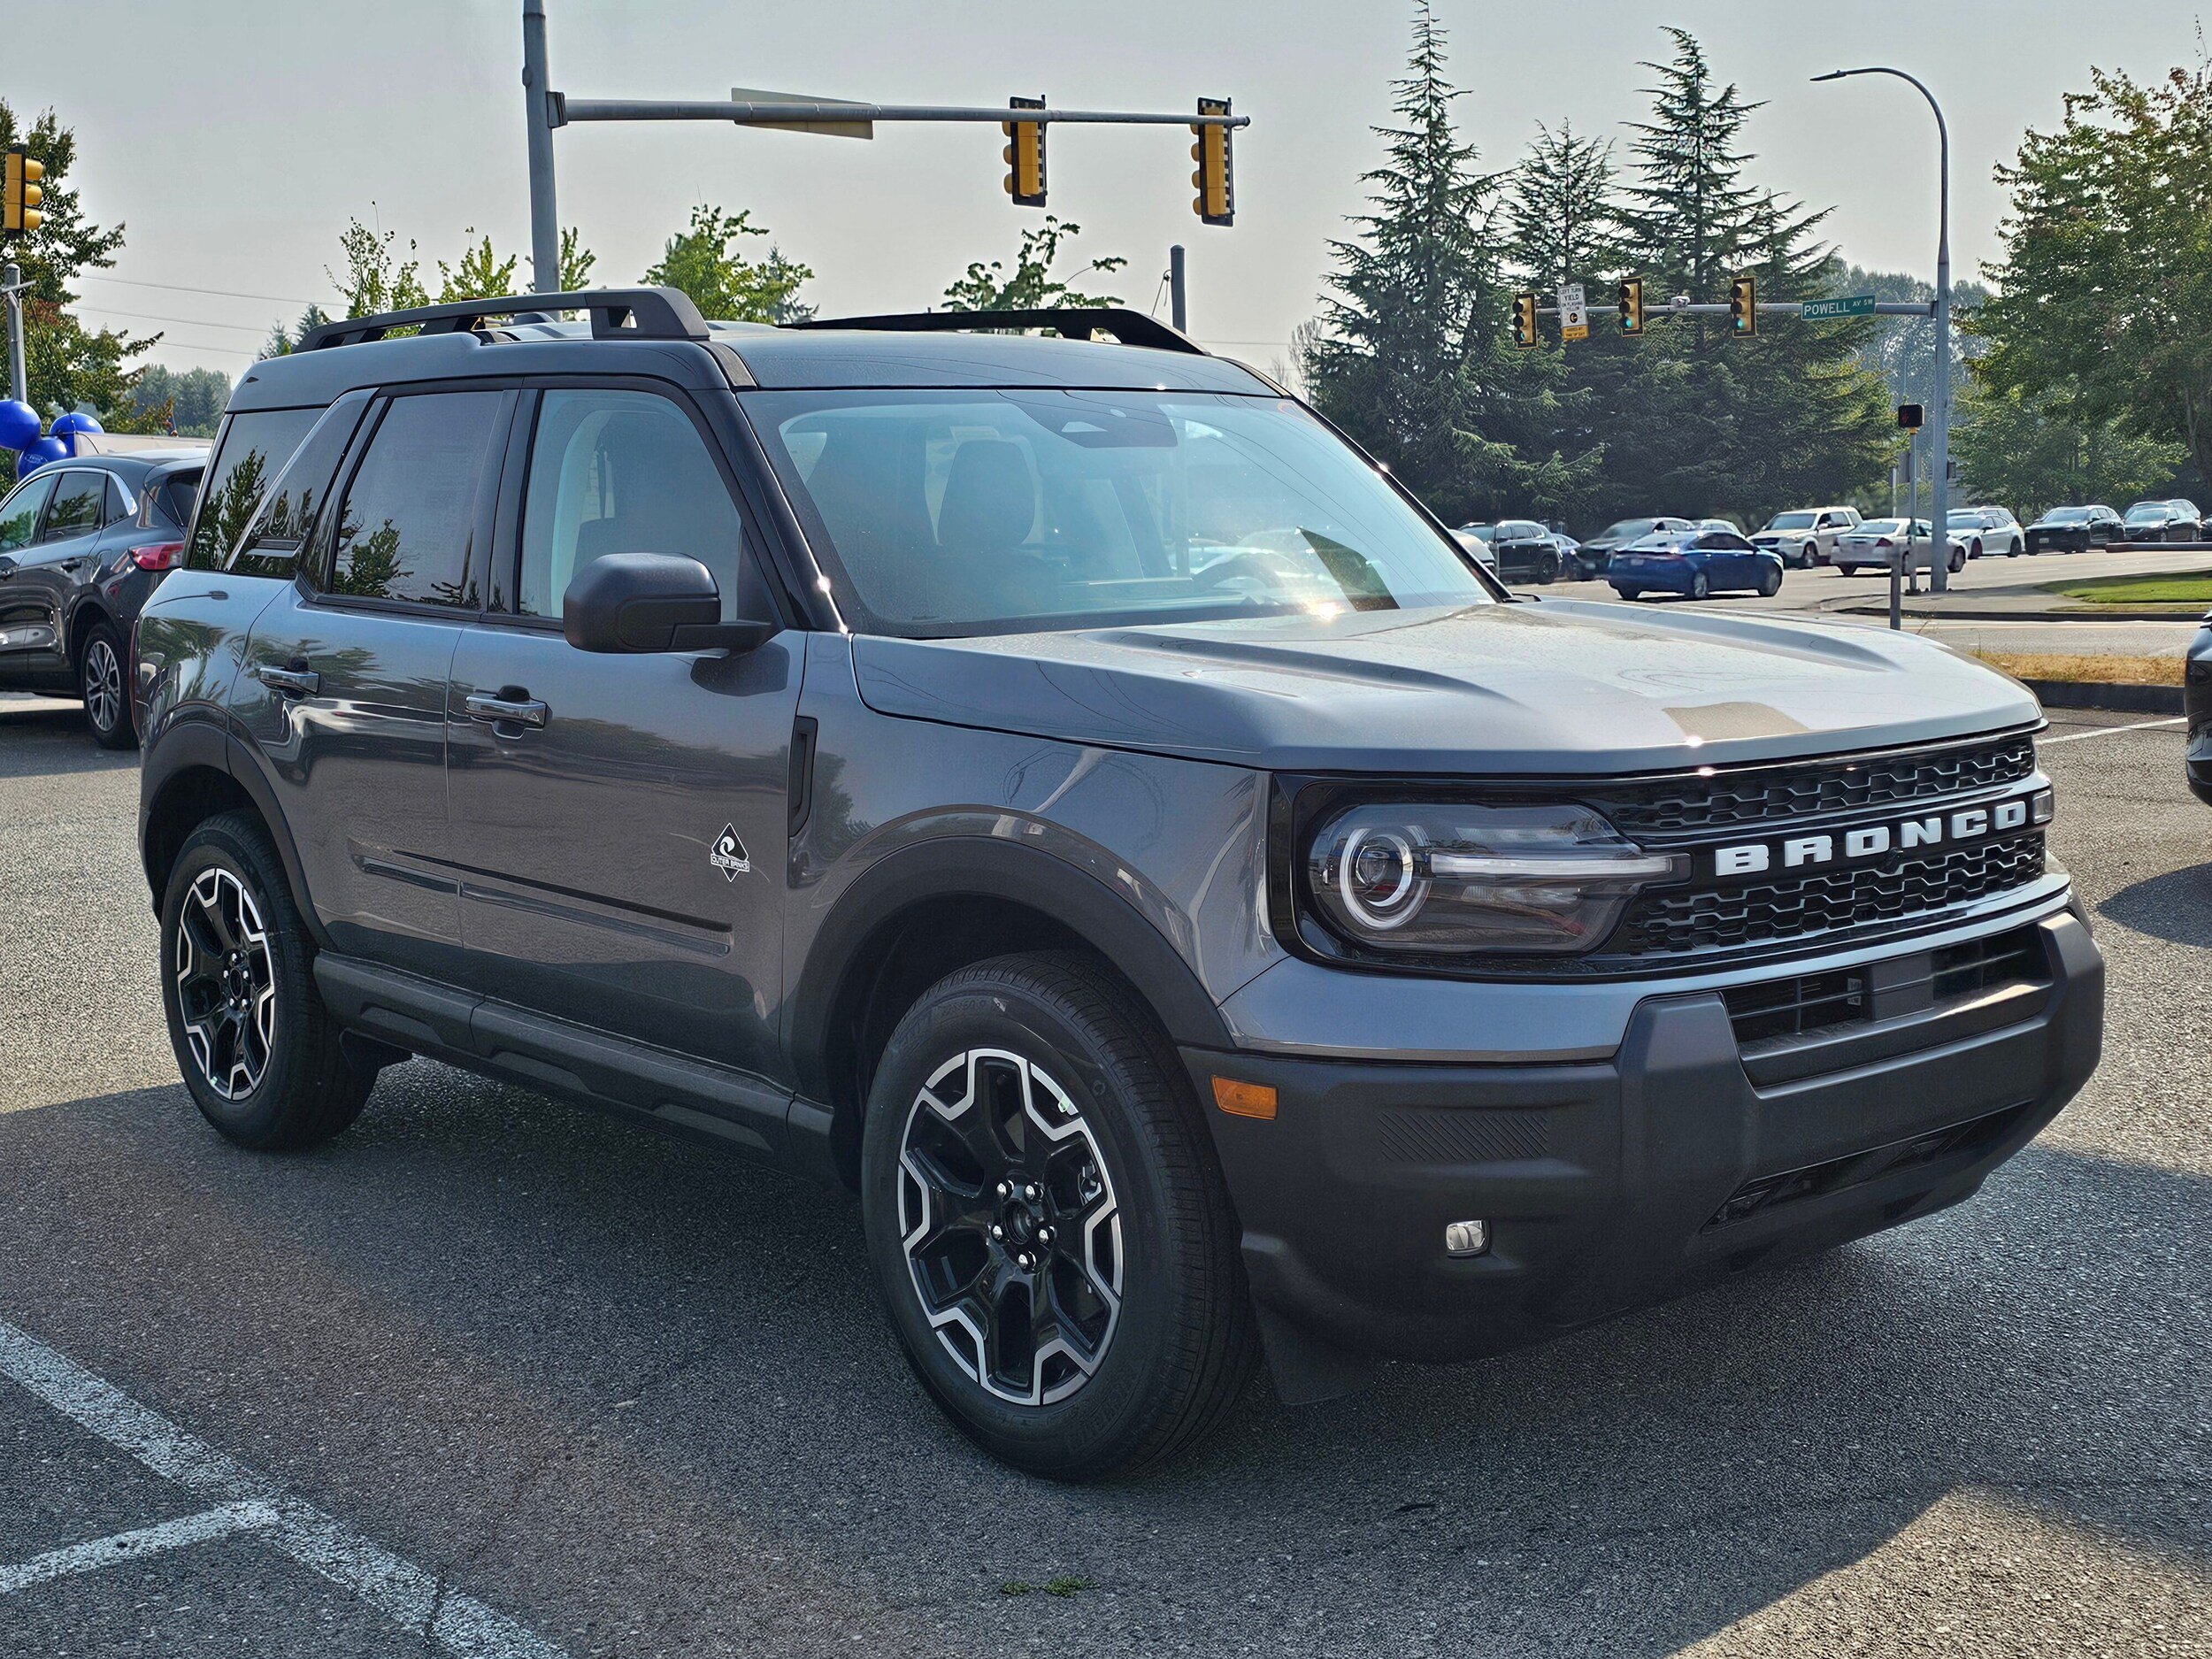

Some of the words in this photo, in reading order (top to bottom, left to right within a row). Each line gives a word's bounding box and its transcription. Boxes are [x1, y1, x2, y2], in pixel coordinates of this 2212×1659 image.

[1803, 302, 1850, 316] POWELL
[1715, 801, 2026, 876] BRONCO
[712, 856, 729, 865] OUTER
[730, 860, 748, 870] BANKS
